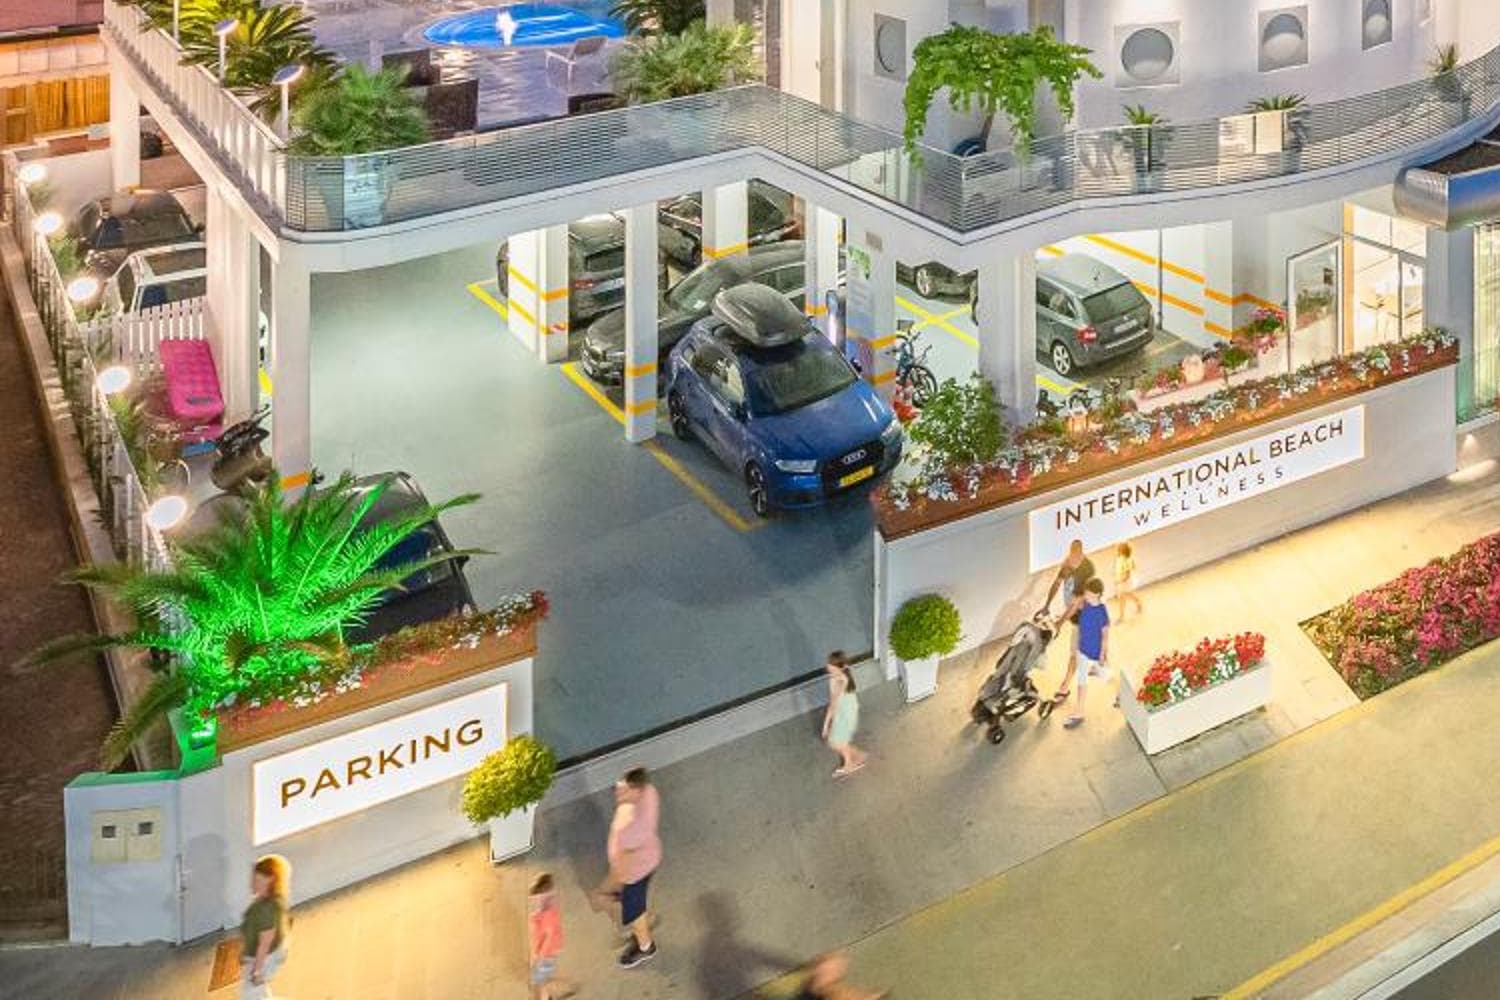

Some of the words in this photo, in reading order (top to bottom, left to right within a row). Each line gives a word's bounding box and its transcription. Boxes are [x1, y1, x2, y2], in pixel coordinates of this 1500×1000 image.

[1056, 453, 1261, 531] INTERNATIONAL
[1269, 418, 1345, 459] BEACH
[1133, 466, 1285, 527] WELLNESS
[280, 718, 484, 809] PARKING
